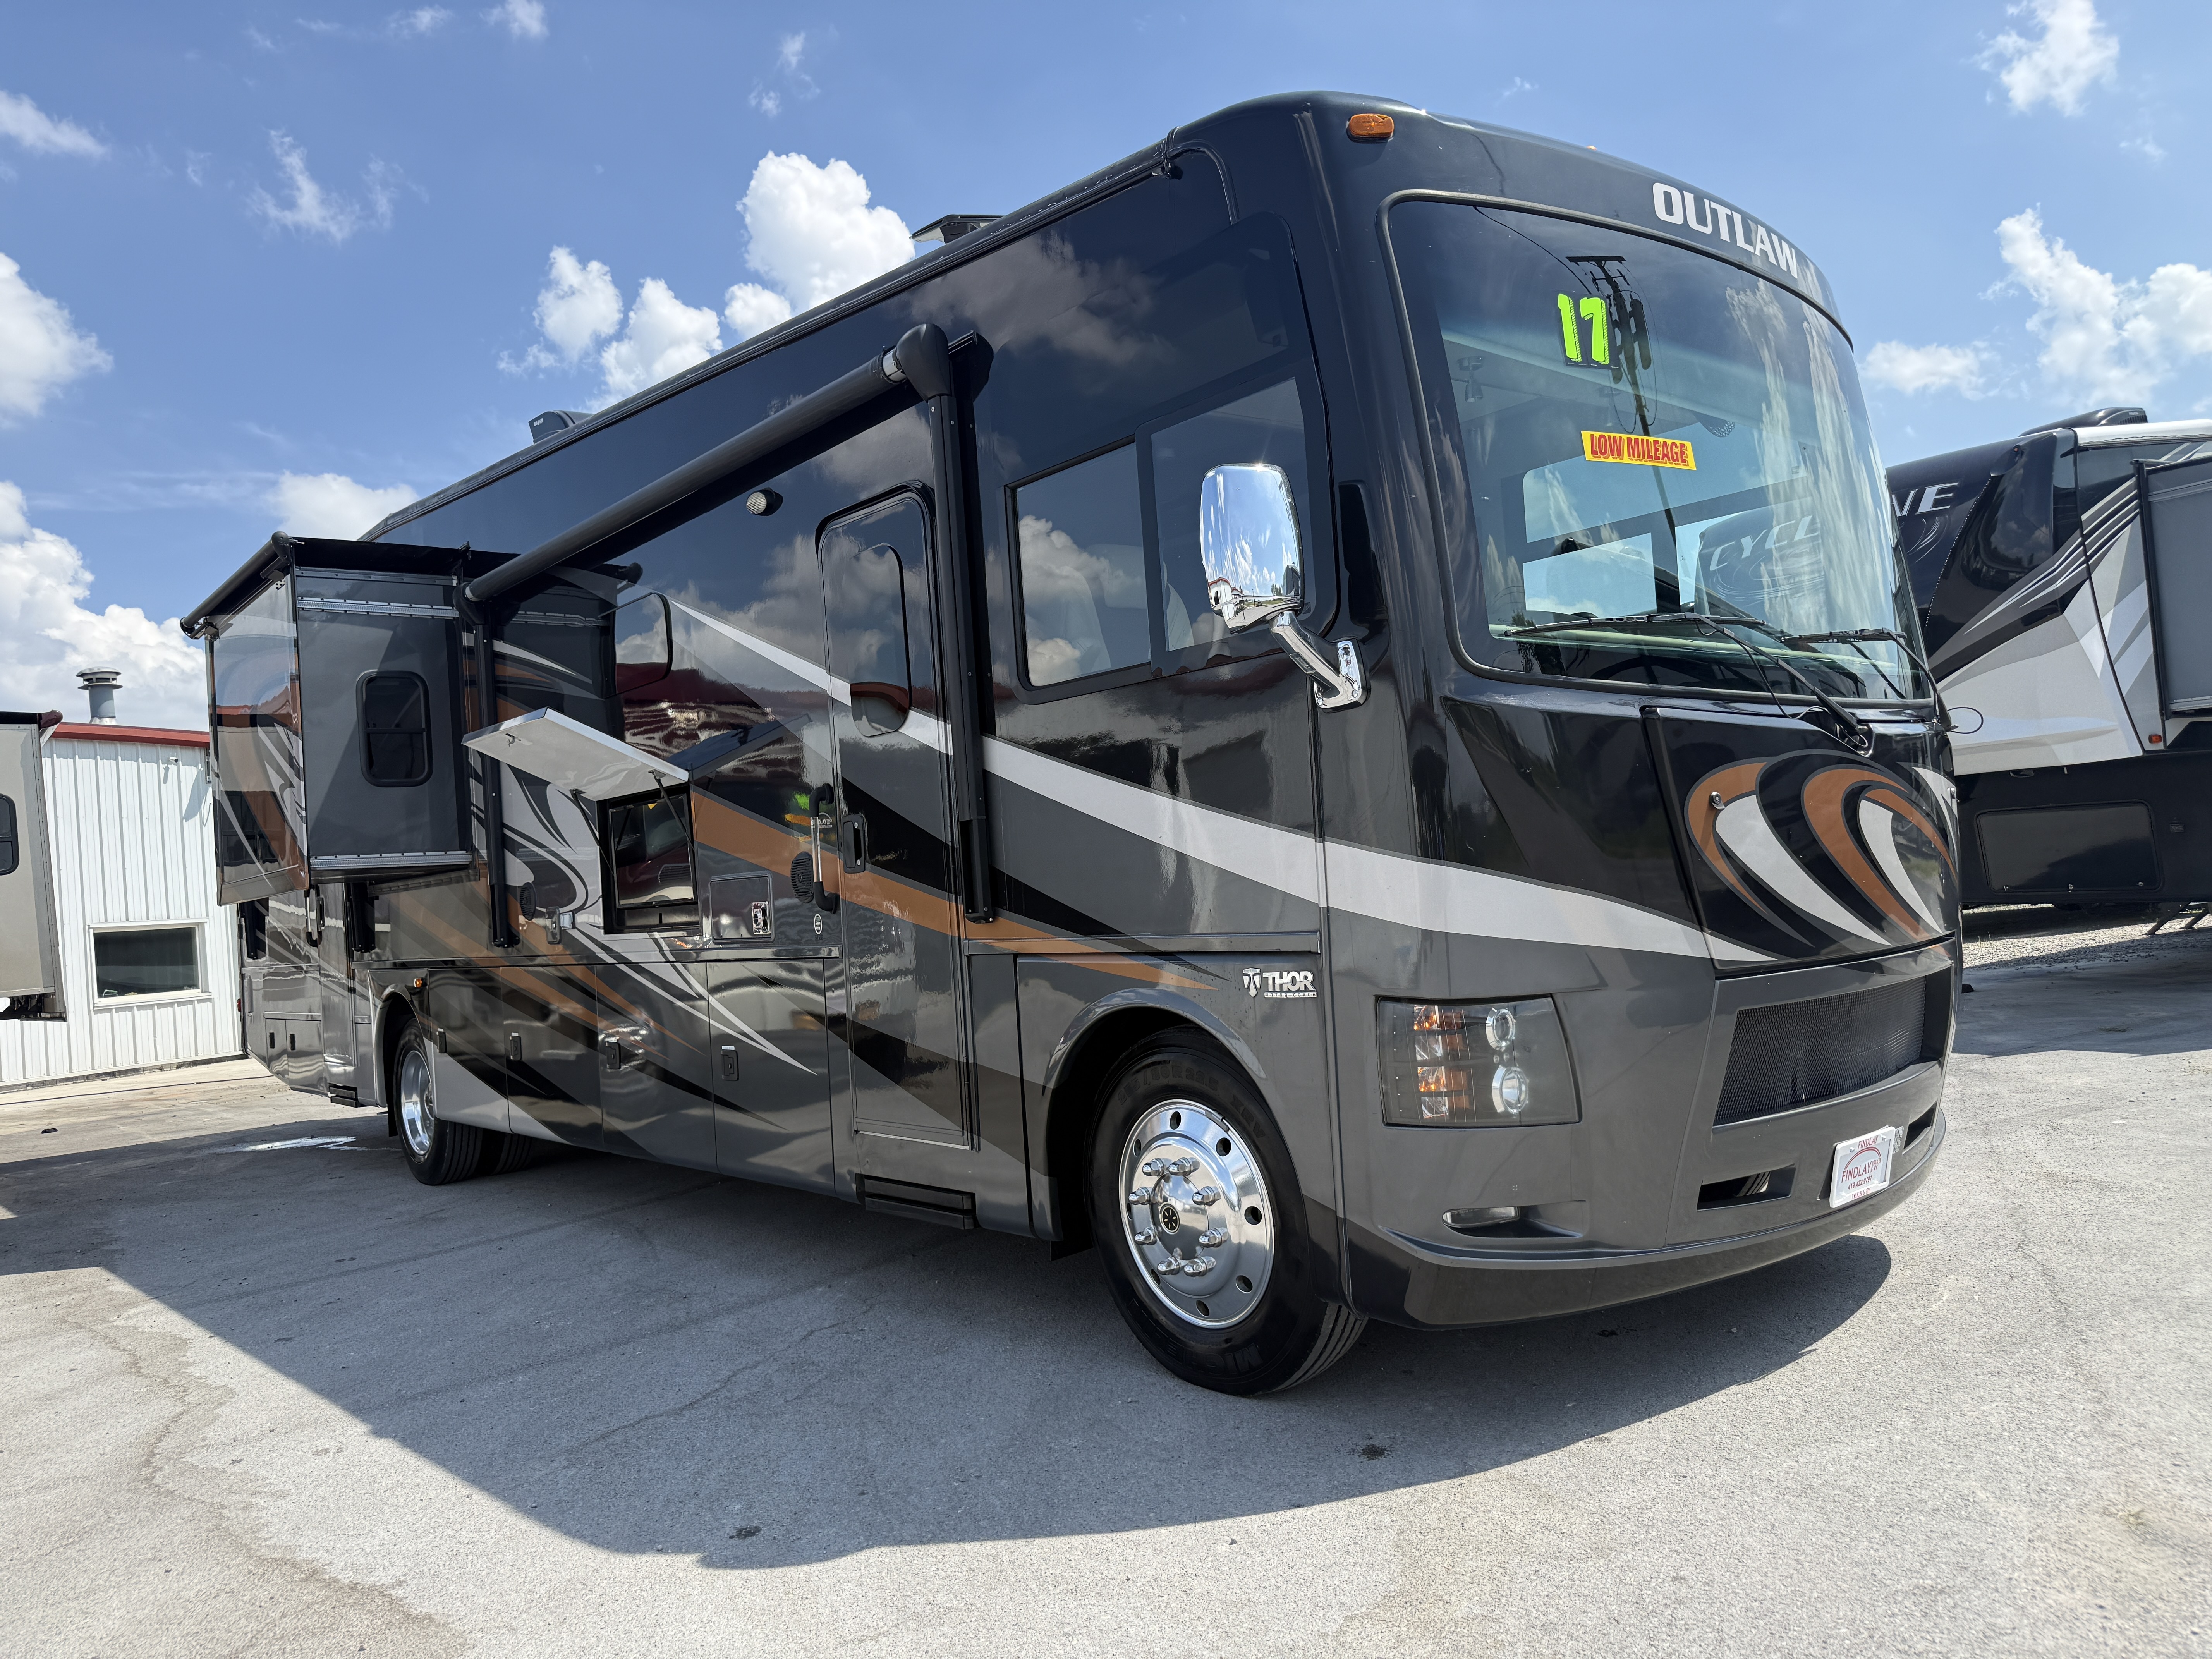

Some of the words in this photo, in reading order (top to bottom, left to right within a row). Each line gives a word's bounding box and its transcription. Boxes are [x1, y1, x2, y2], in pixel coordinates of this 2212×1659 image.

[1653, 182, 1798, 279] OUTLAW
[1558, 293, 1609, 365] 17
[1590, 433, 1624, 459] LOW
[1627, 437, 1689, 466] MILEAGE
[1262, 971, 1316, 991] THOR
[1230, 1094, 1266, 1138] XRV
[1858, 1135, 1879, 1150] FINDLAY
[1841, 1161, 1872, 1183] FINDLAY
